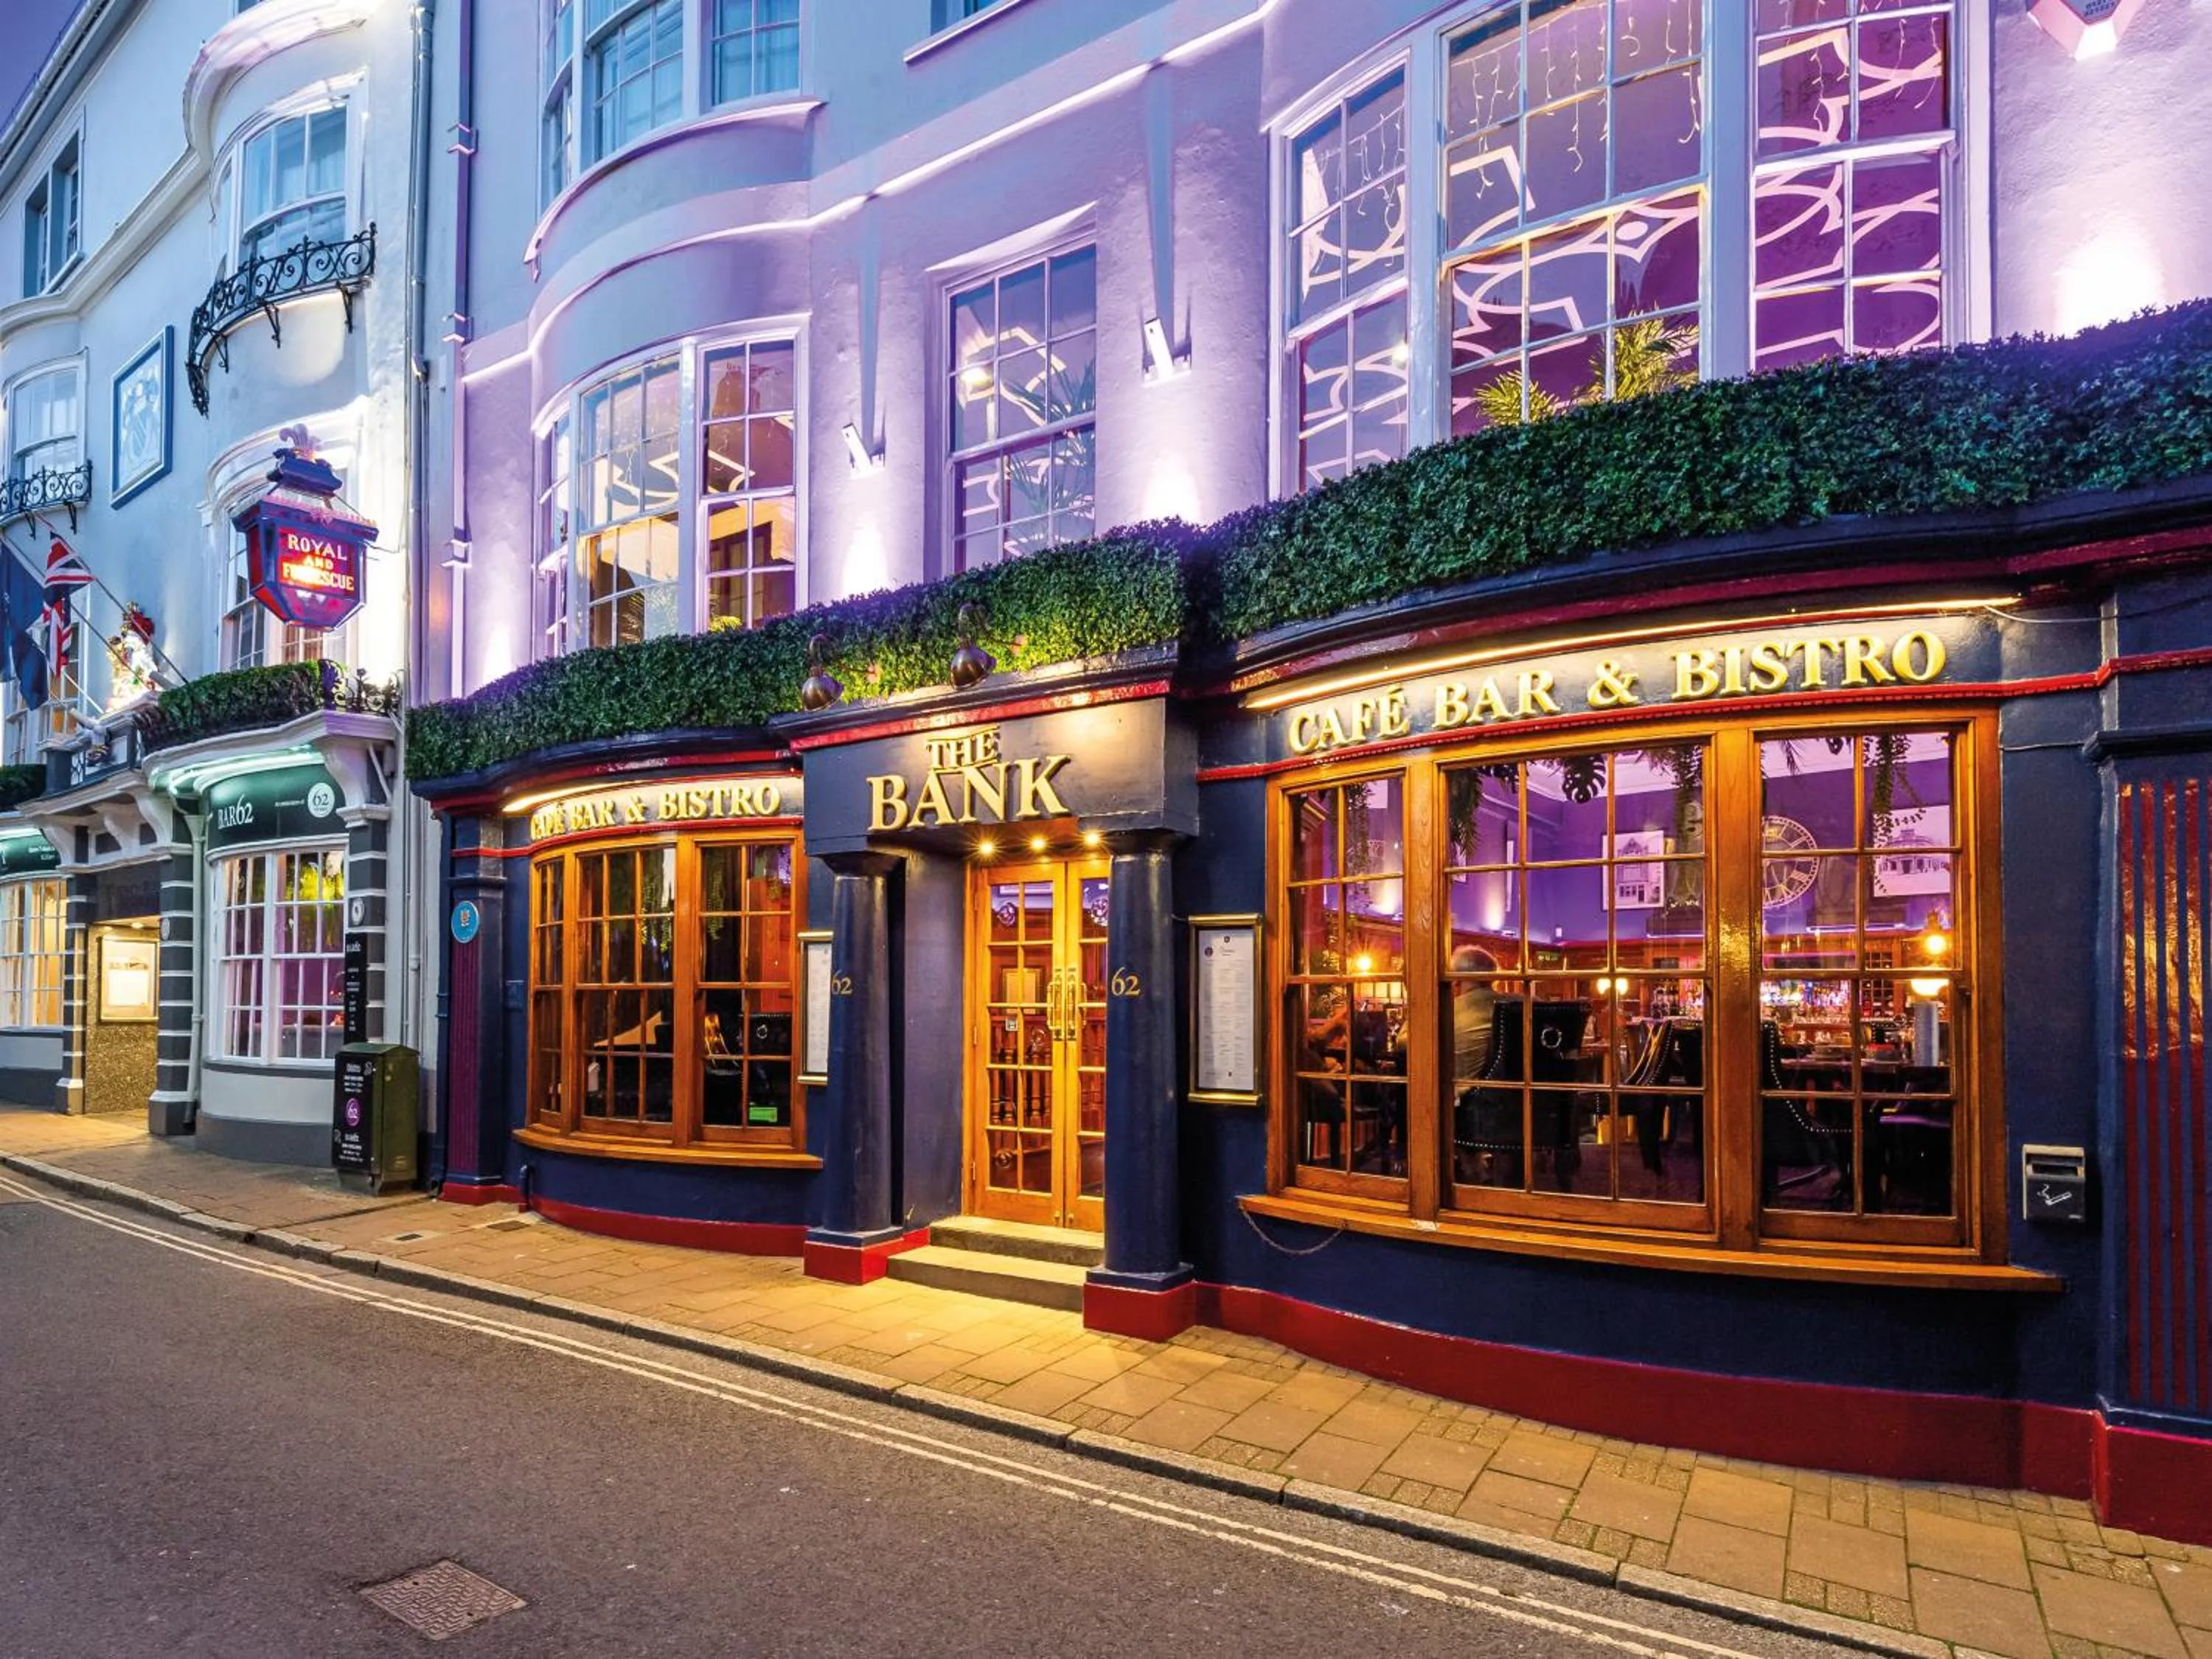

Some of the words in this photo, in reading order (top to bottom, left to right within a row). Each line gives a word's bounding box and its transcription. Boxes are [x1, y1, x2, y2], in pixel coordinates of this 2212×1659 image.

[288, 534, 347, 560] ROYAL
[304, 554, 334, 570] AND
[1289, 685, 1410, 754] CAFÉ
[1433, 669, 1561, 728] BAR
[1587, 660, 1639, 707] &
[1672, 630, 1947, 700] BISTRO
[926, 731, 1000, 769] THE
[312, 787, 330, 807] 62
[569, 799, 616, 831] BAR
[625, 793, 647, 824] &
[658, 783, 781, 821] BISTRO
[866, 754, 1071, 832] BANK
[218, 793, 254, 830] BAR62
[831, 969, 852, 995] 62
[1111, 967, 1141, 996] 62
